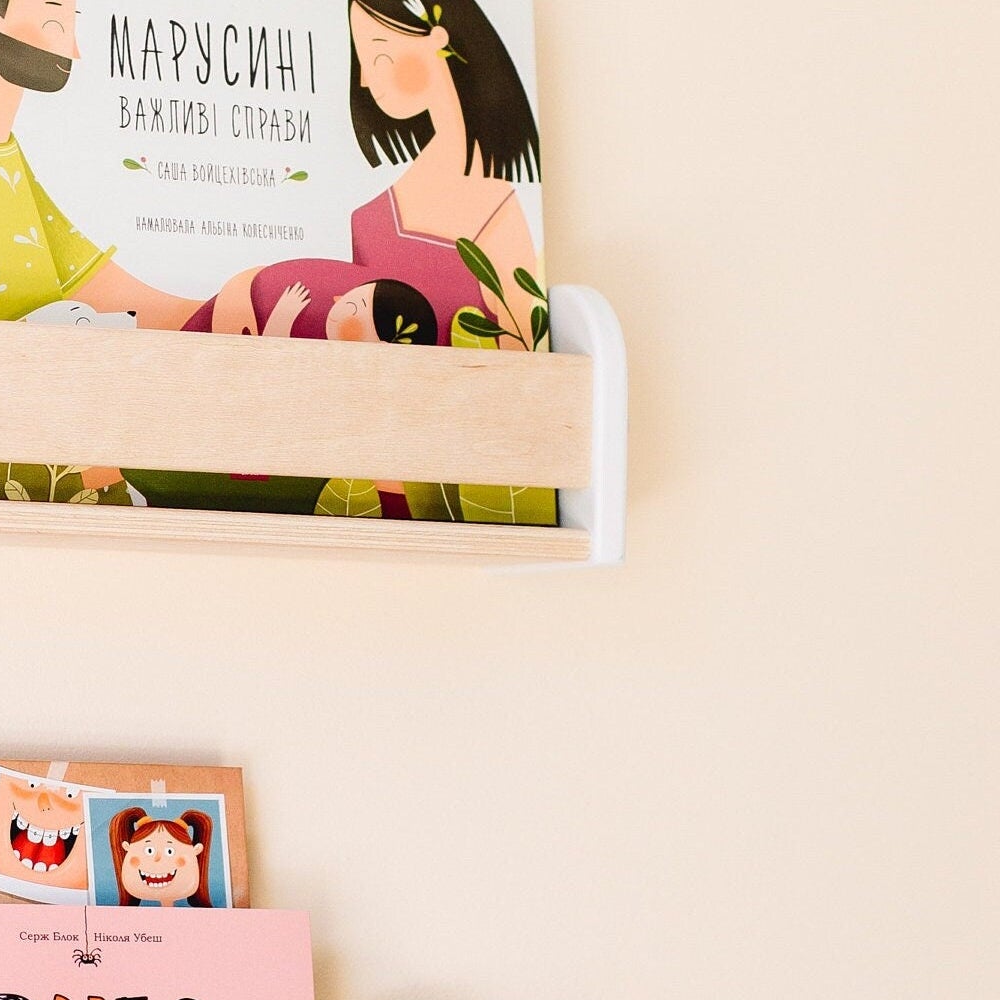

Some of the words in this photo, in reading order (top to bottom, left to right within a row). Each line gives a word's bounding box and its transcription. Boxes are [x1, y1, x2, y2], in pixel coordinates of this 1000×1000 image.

[110, 14, 315, 94] МАРУСИНІ
[119, 95, 217, 137] ВАЖЛИВІ
[232, 104, 311, 143] СПРАВИ
[157, 161, 187, 181] САША
[192, 163, 276, 187] ВОЙЦЕХІВСЬКА
[136, 216, 195, 234] НАМАЛЮВАЛА
[201, 219, 238, 238] АЛЬБІНА
[242, 223, 305, 241] КОЛЕСНІЧЕНКО
[19, 931, 50, 943] Серж
[53, 931, 79, 942] Блок
[94, 932, 130, 943] Ніколя
[133, 933, 163, 943] Убеш
